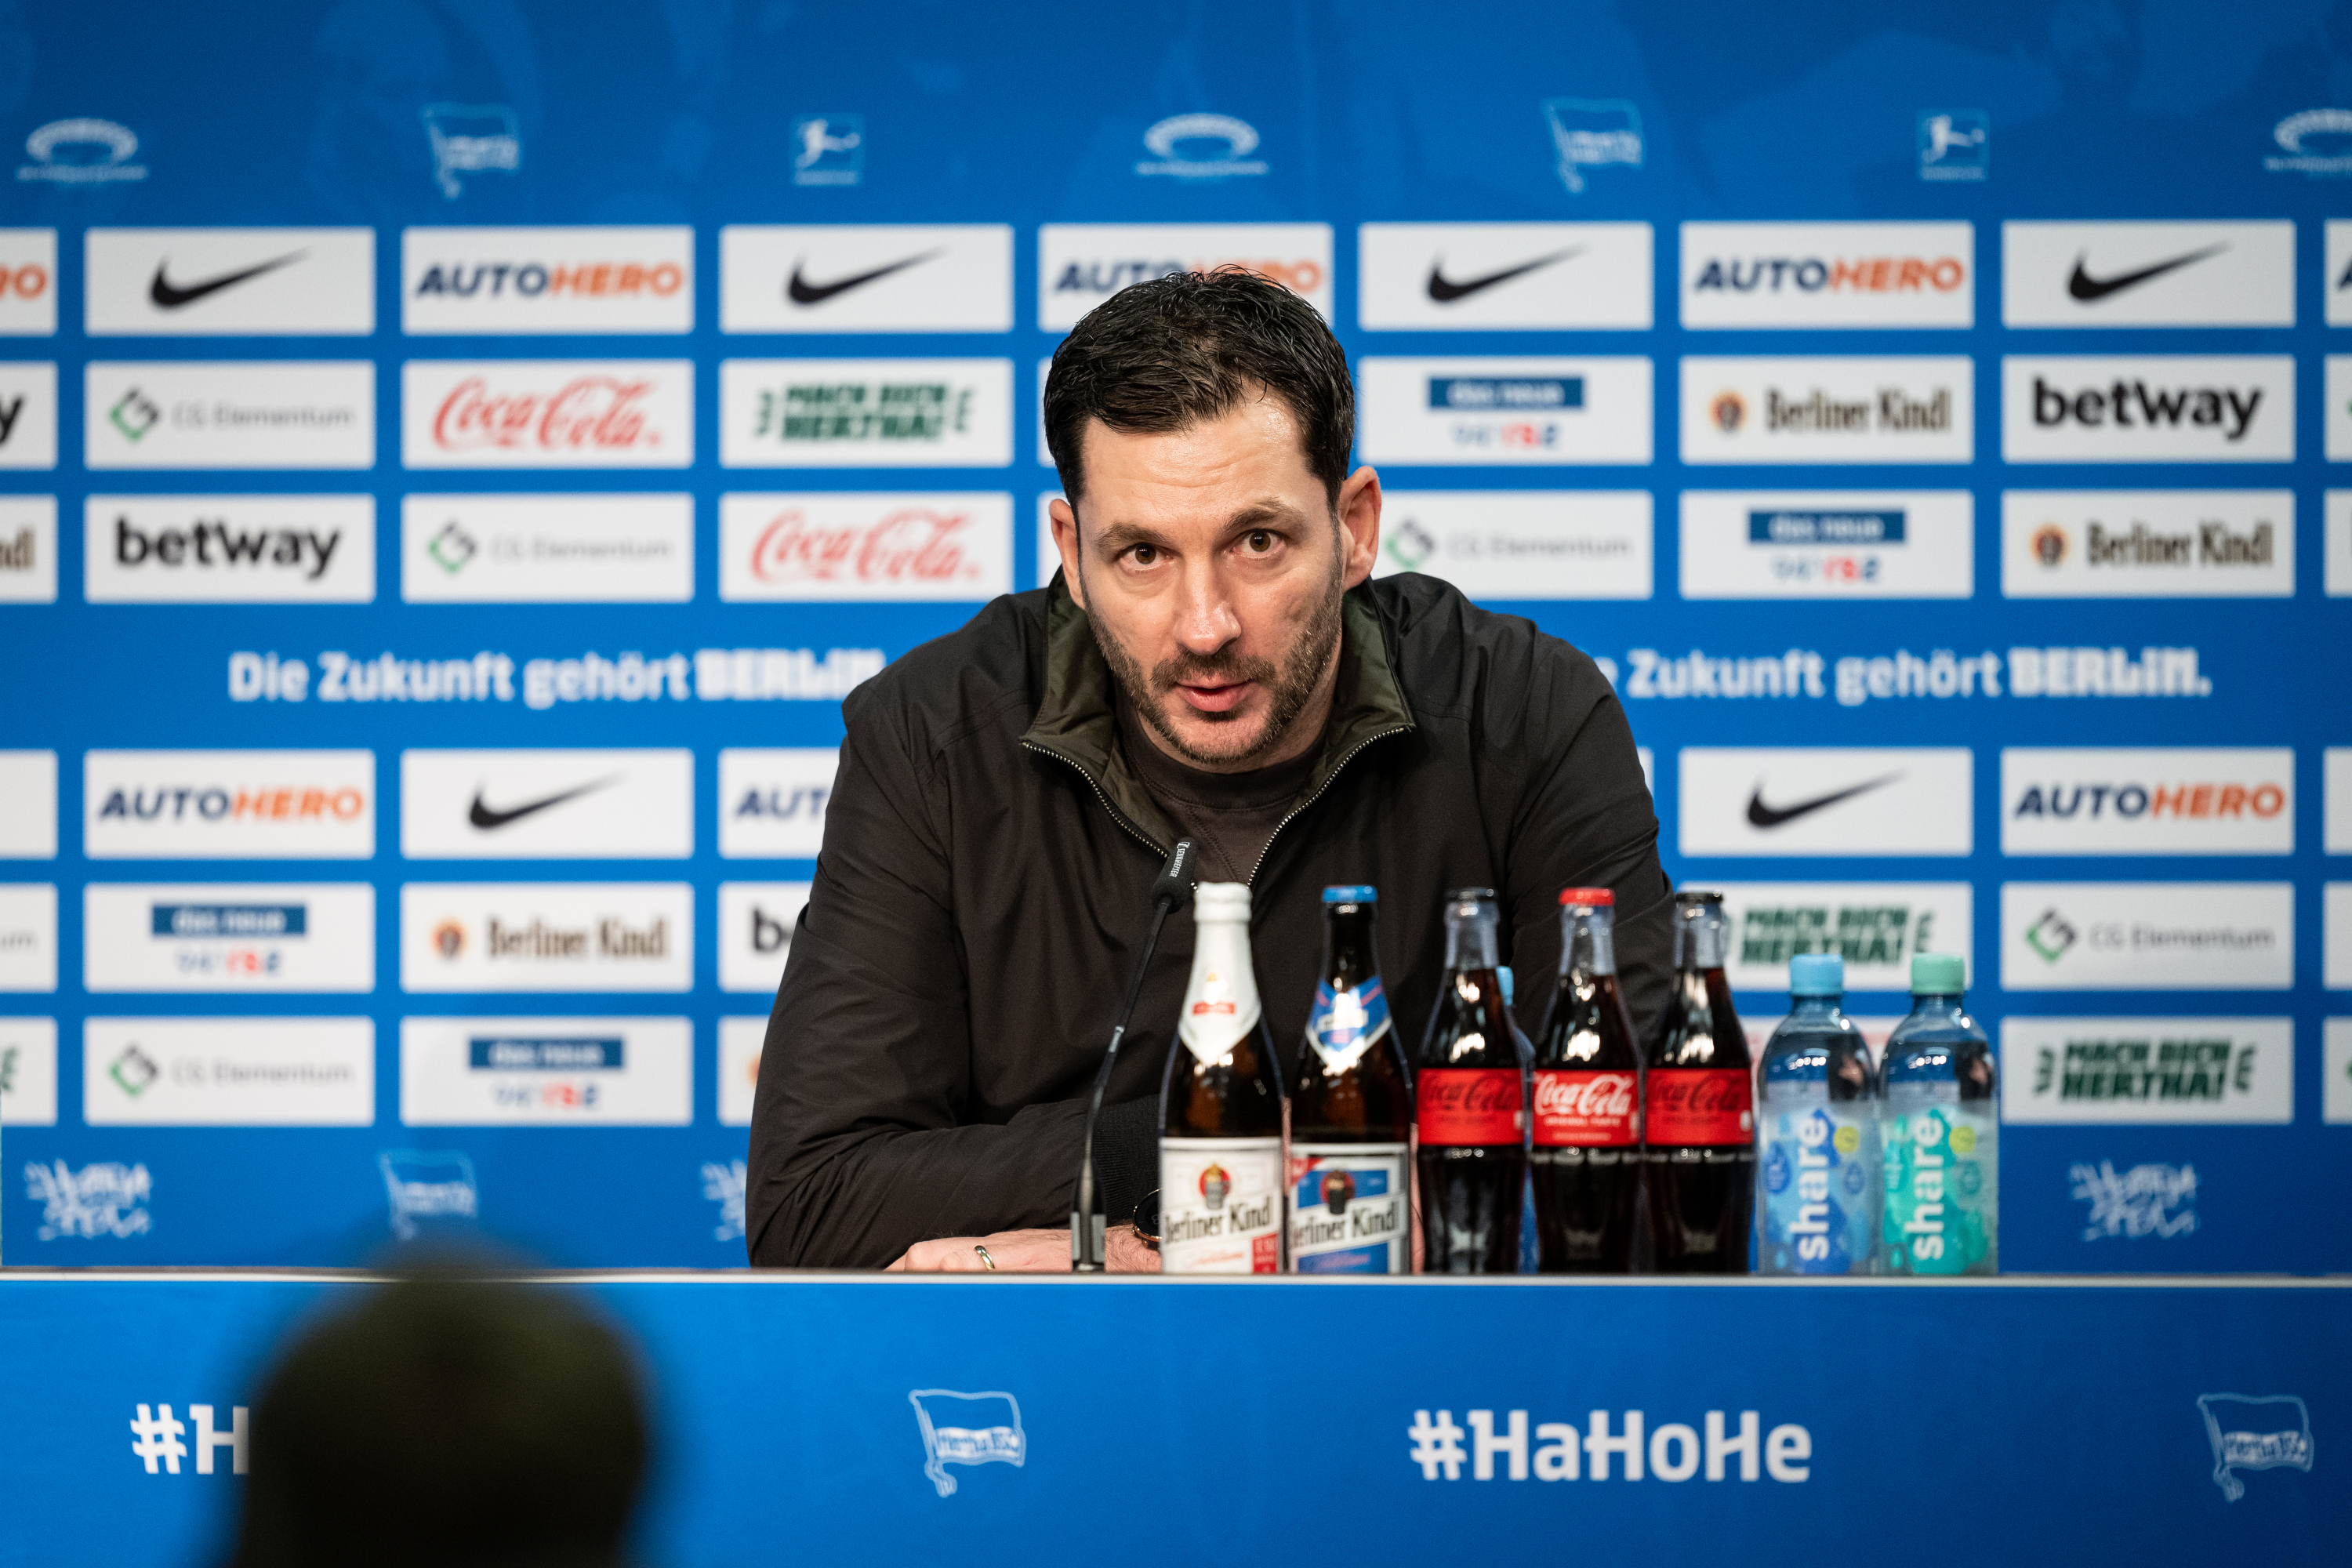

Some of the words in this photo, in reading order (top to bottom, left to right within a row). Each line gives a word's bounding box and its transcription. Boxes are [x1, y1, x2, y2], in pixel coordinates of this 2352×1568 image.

[415, 263, 682, 298] AUTOHERO
[1694, 258, 1964, 292] AUTOHERO
[211, 401, 352, 428] Elementum
[1766, 387, 1870, 432] Berliner
[1878, 387, 1951, 432] Kindl
[2033, 376, 2263, 441] betway
[115, 516, 339, 579] betway
[529, 534, 672, 561] Elementum
[1489, 533, 1631, 557] Elementum
[2088, 521, 2192, 566] Berliner
[2199, 521, 2274, 566] Kindl
[229, 652, 309, 702] Die
[318, 652, 514, 702] Zukunft
[524, 652, 689, 710] gehört
[1627, 649, 1824, 699] Zukunft
[1835, 650, 2001, 706] gehört
[99, 787, 364, 821] AUTOHERO
[2015, 783, 2285, 818] AUTOHERO
[488, 917, 590, 959] Berliner
[597, 917, 666, 959] Kindl
[2131, 924, 2275, 952] Elementum
[211, 1058, 352, 1086] Elementum
[1788, 1115, 1829, 1261] share
[1904, 1115, 1945, 1261] share
[1229, 1196, 1271, 1233] Kindl
[1352, 1200, 1399, 1238] Kindl
[1408, 1409, 1812, 1483] #HaHoHe
